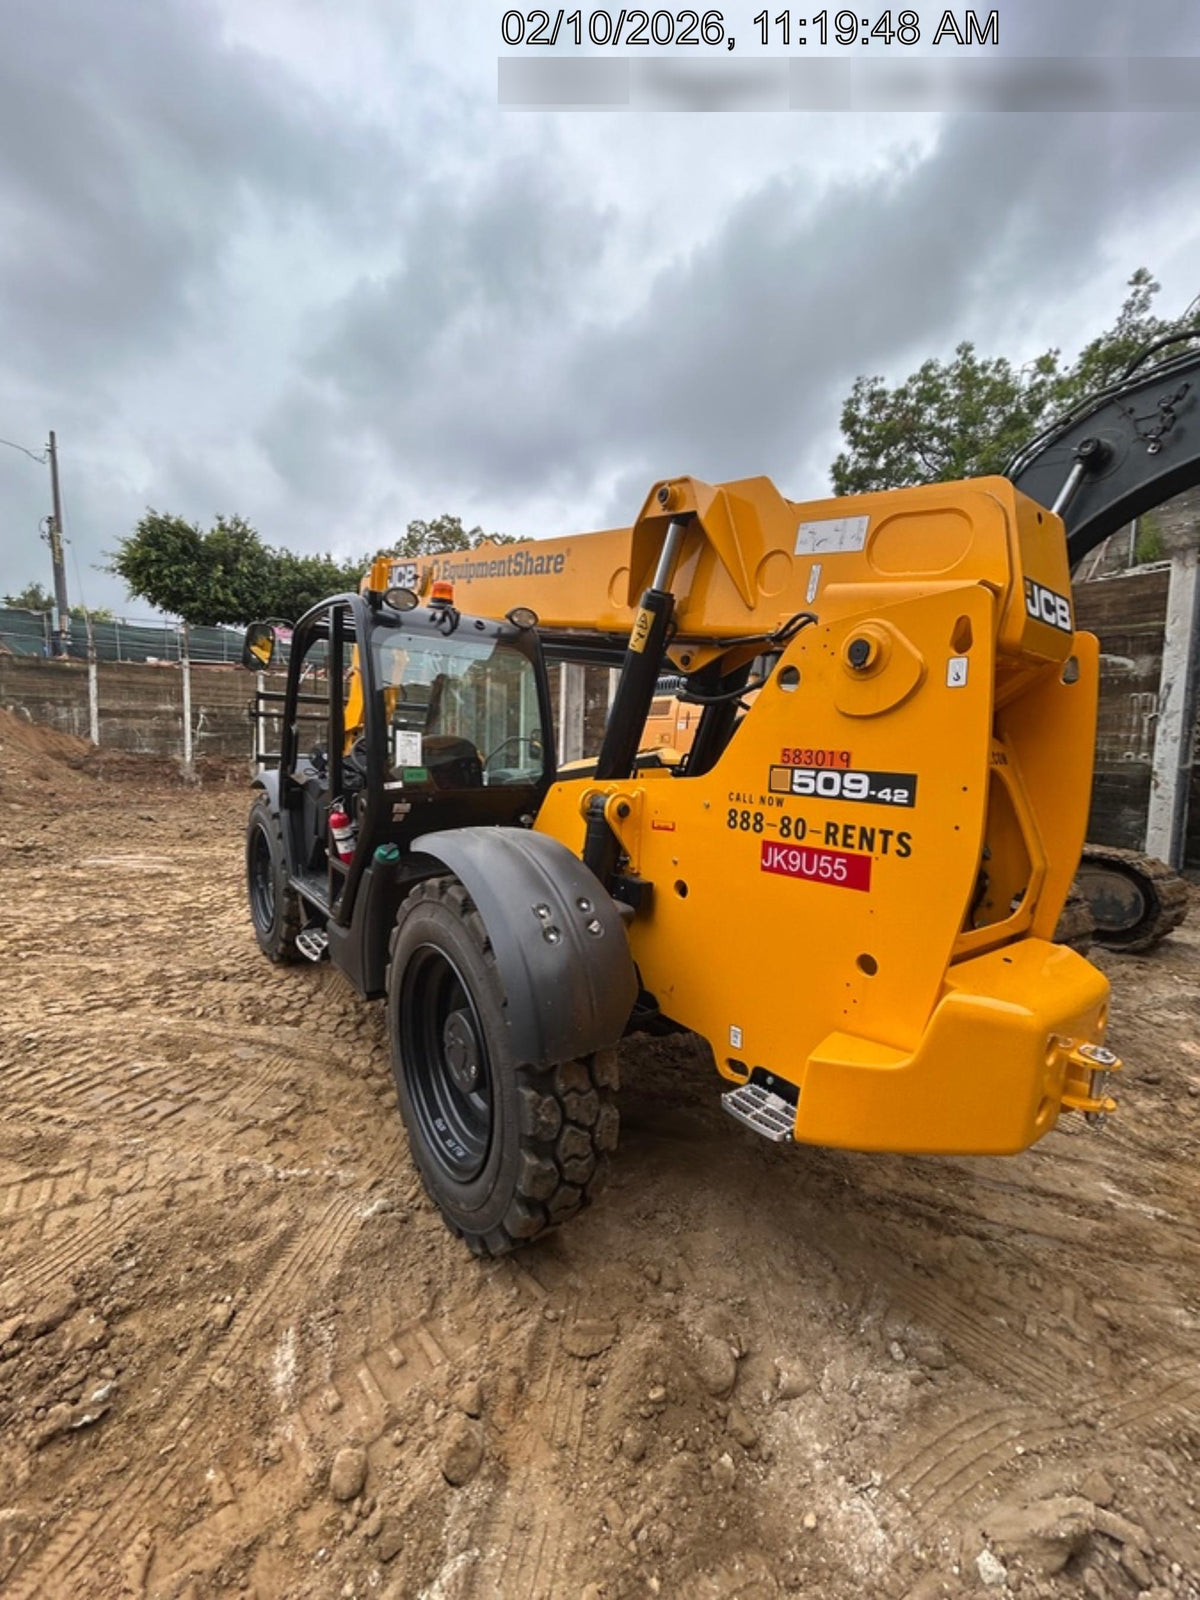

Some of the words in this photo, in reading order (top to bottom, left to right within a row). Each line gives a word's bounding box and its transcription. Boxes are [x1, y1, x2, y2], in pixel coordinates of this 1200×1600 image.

[388, 565, 416, 588] JCB
[442, 551, 565, 584] EquipmentShare
[1026, 584, 1071, 632] JCB
[782, 748, 851, 768] 583019
[728, 792, 754, 804] CALL
[759, 796, 784, 808] NOW
[792, 769, 909, 804] 509-42
[727, 808, 912, 858] 888-80-RENTS
[762, 847, 847, 881] JK9U55
